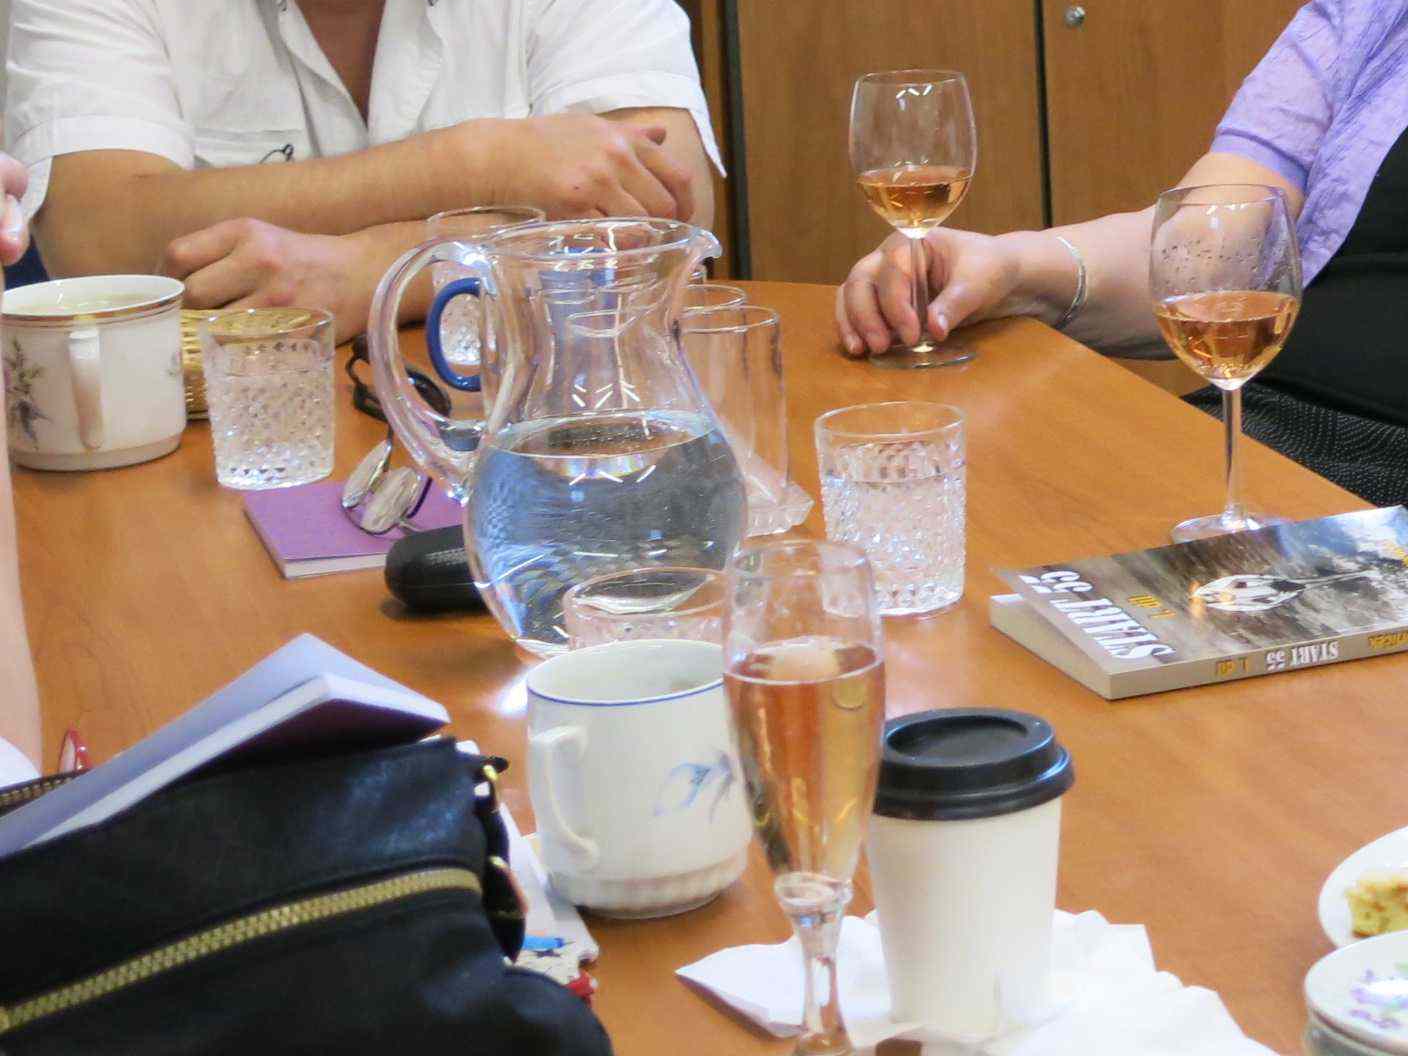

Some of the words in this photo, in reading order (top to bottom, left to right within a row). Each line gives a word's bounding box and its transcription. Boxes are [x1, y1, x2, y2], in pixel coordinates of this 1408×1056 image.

[1018, 570, 1093, 594] 55
[1049, 597, 1176, 659] START
[1265, 649, 1286, 672] 55
[1290, 641, 1339, 666] START
